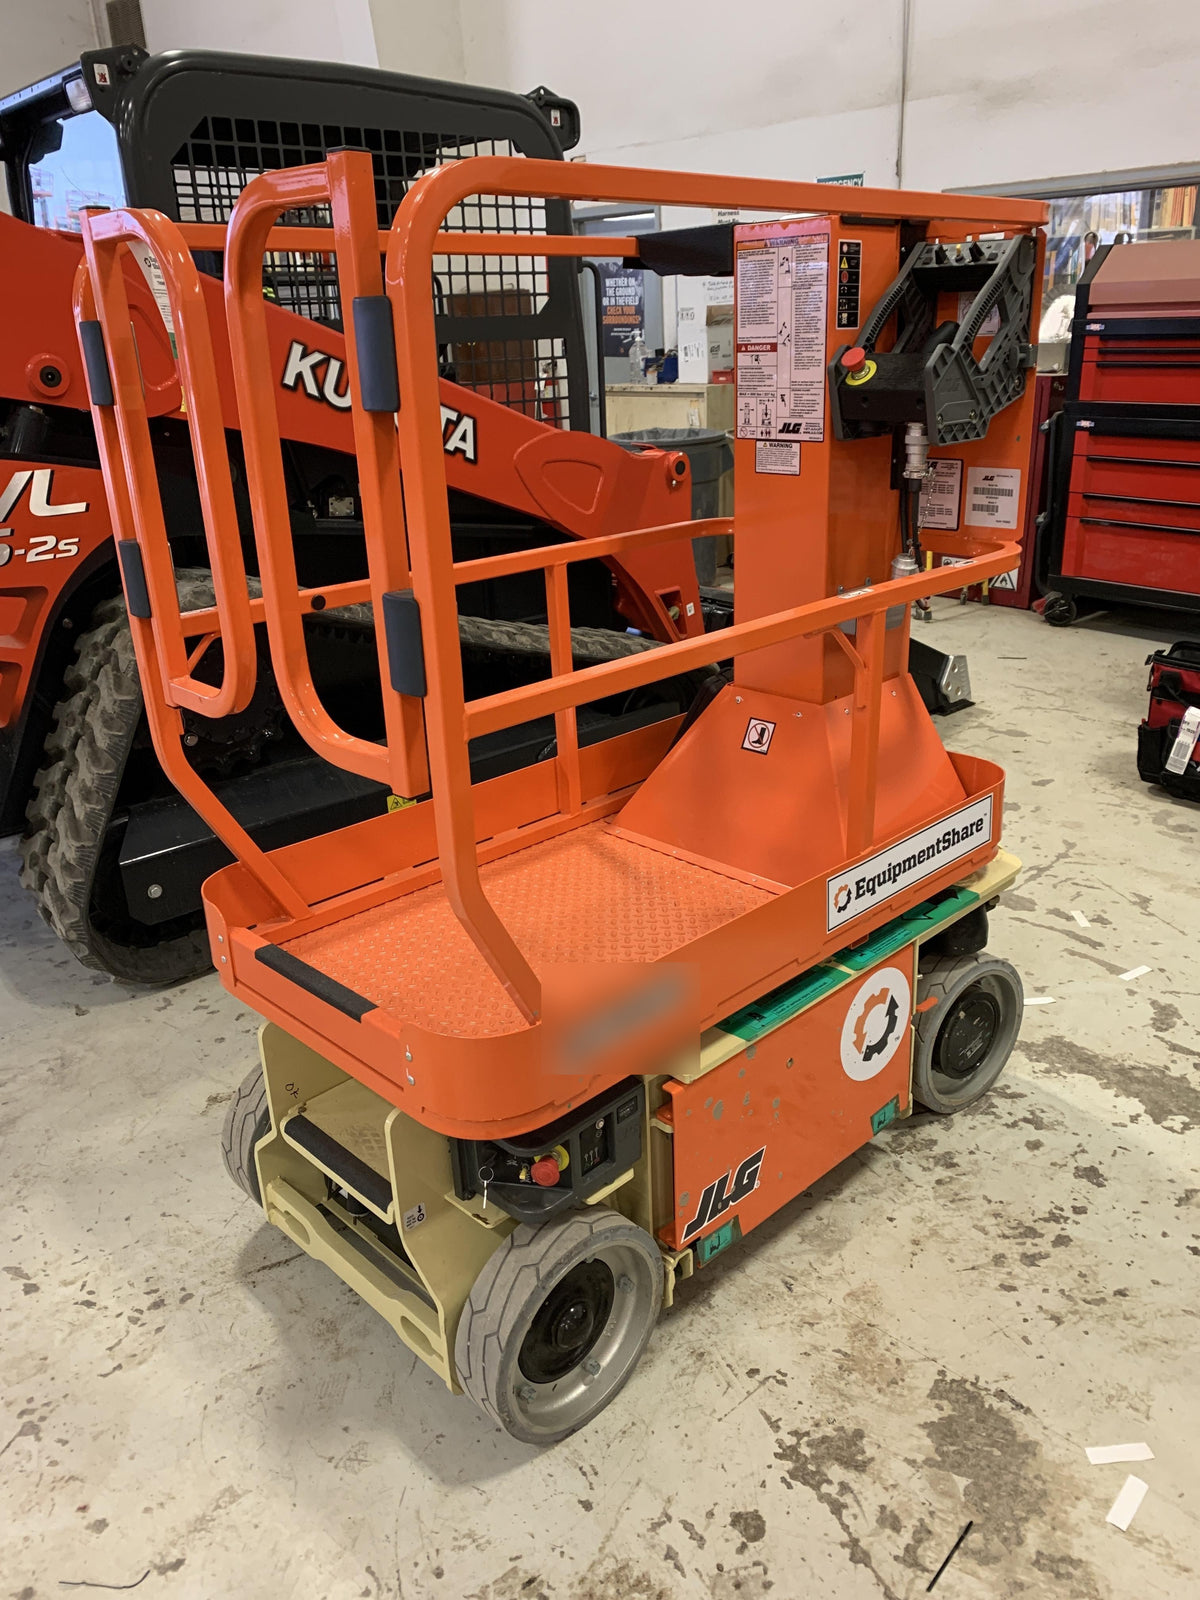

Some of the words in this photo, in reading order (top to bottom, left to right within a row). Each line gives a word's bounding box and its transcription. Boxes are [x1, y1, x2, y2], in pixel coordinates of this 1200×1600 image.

[605, 277, 628, 287] WHETHER
[628, 277, 636, 287] ON
[606, 287, 615, 296] THE
[615, 287, 636, 296] GROUND
[602, 297, 609, 306] OR
[610, 297, 615, 306] IN
[616, 297, 625, 306] THE
[625, 296, 639, 306] FIELD
[282, 340, 476, 462] KUTA
[778, 422, 802, 434] JLG
[855, 817, 984, 900] EquipmentShare
[285, 1082, 300, 1099] OK
[681, 1145, 767, 1244] JLG
